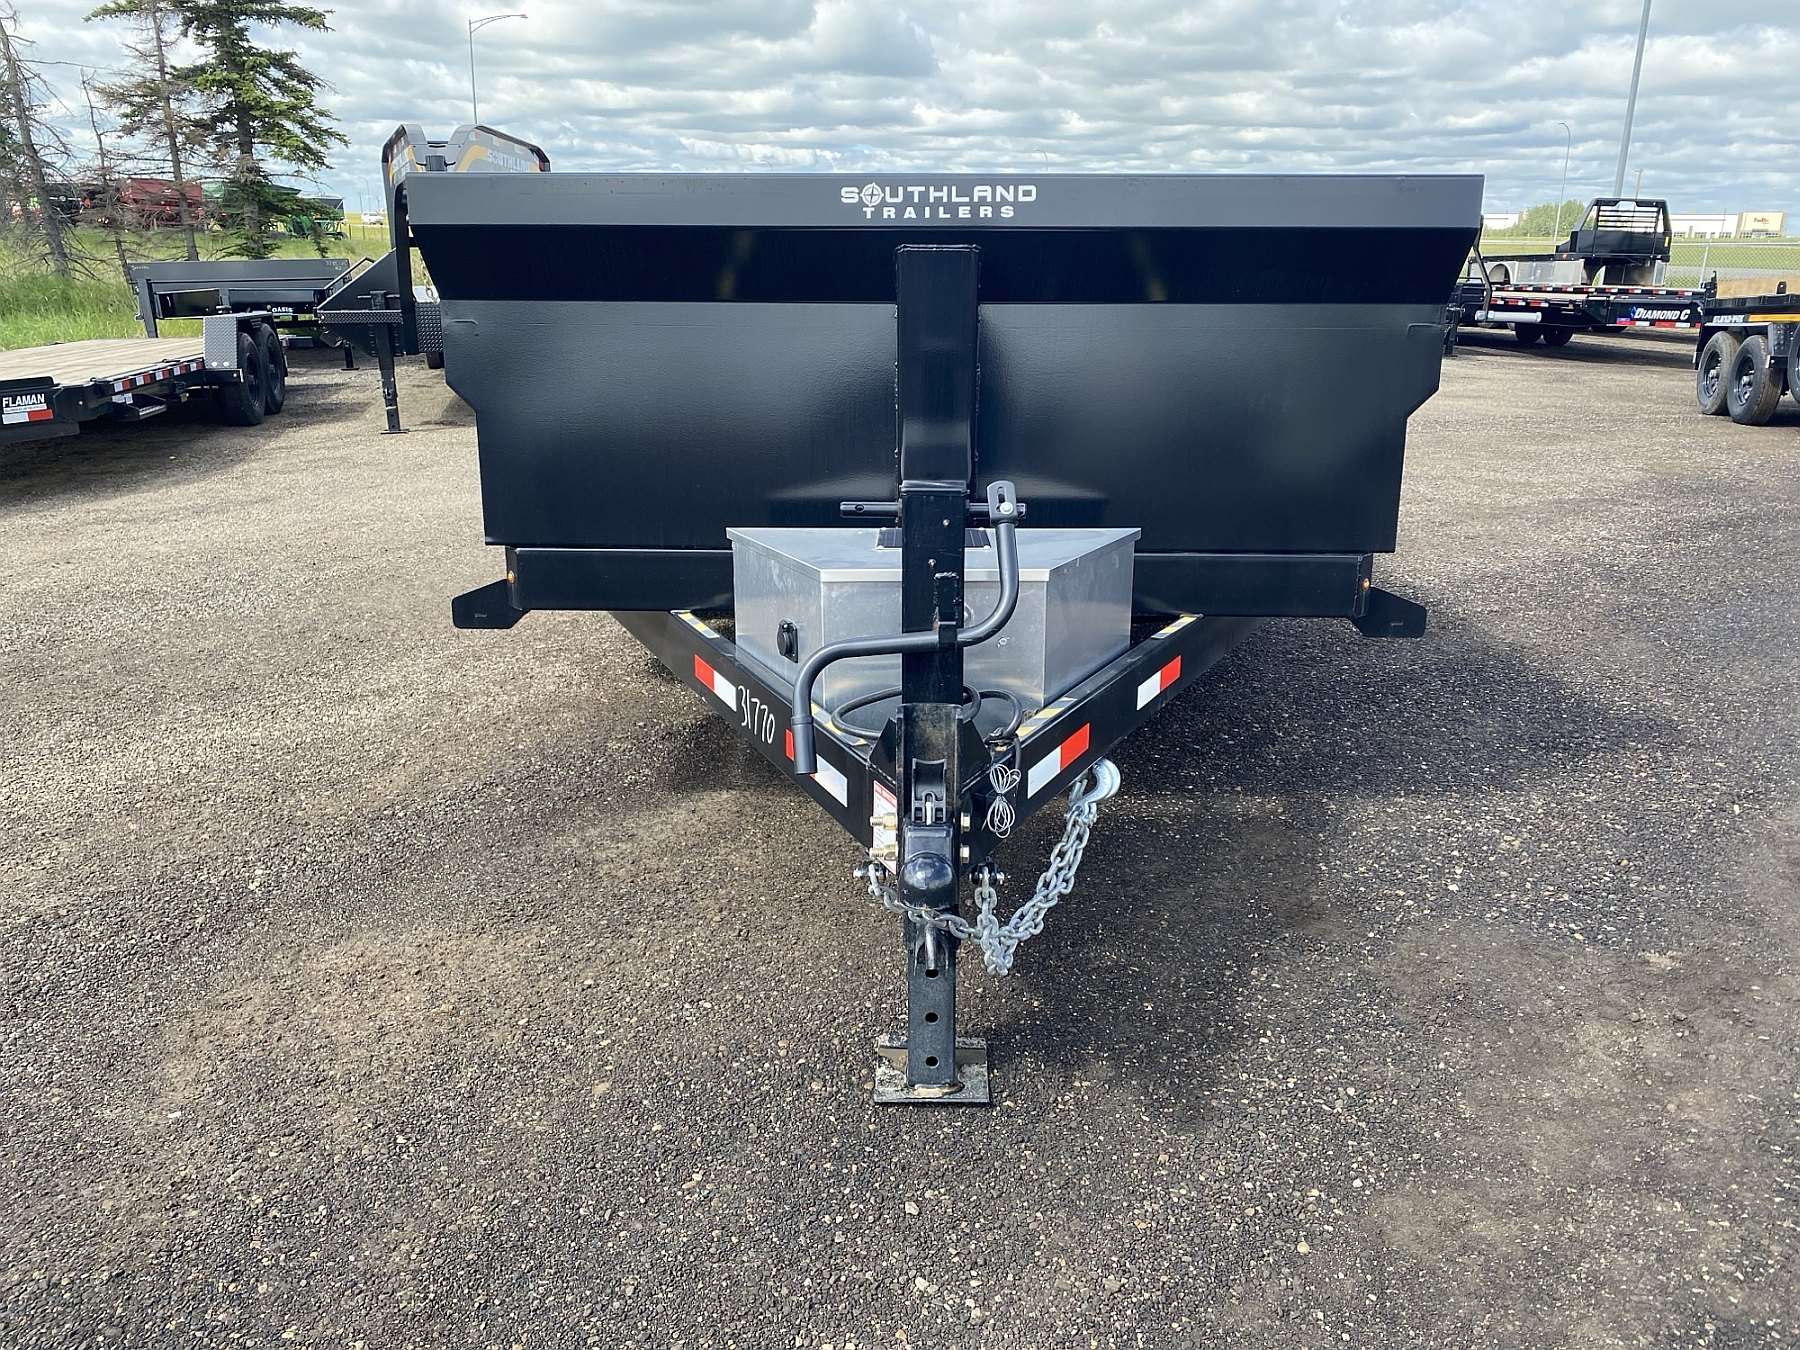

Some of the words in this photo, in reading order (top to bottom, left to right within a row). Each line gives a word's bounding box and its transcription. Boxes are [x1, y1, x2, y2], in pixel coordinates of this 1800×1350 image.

[840, 182, 1037, 206] SOUTHLAND
[862, 205, 1015, 219] TRAILERS
[1680, 309, 1691, 321] C
[2, 393, 45, 408] FLAMAN
[738, 685, 775, 744] 31770
